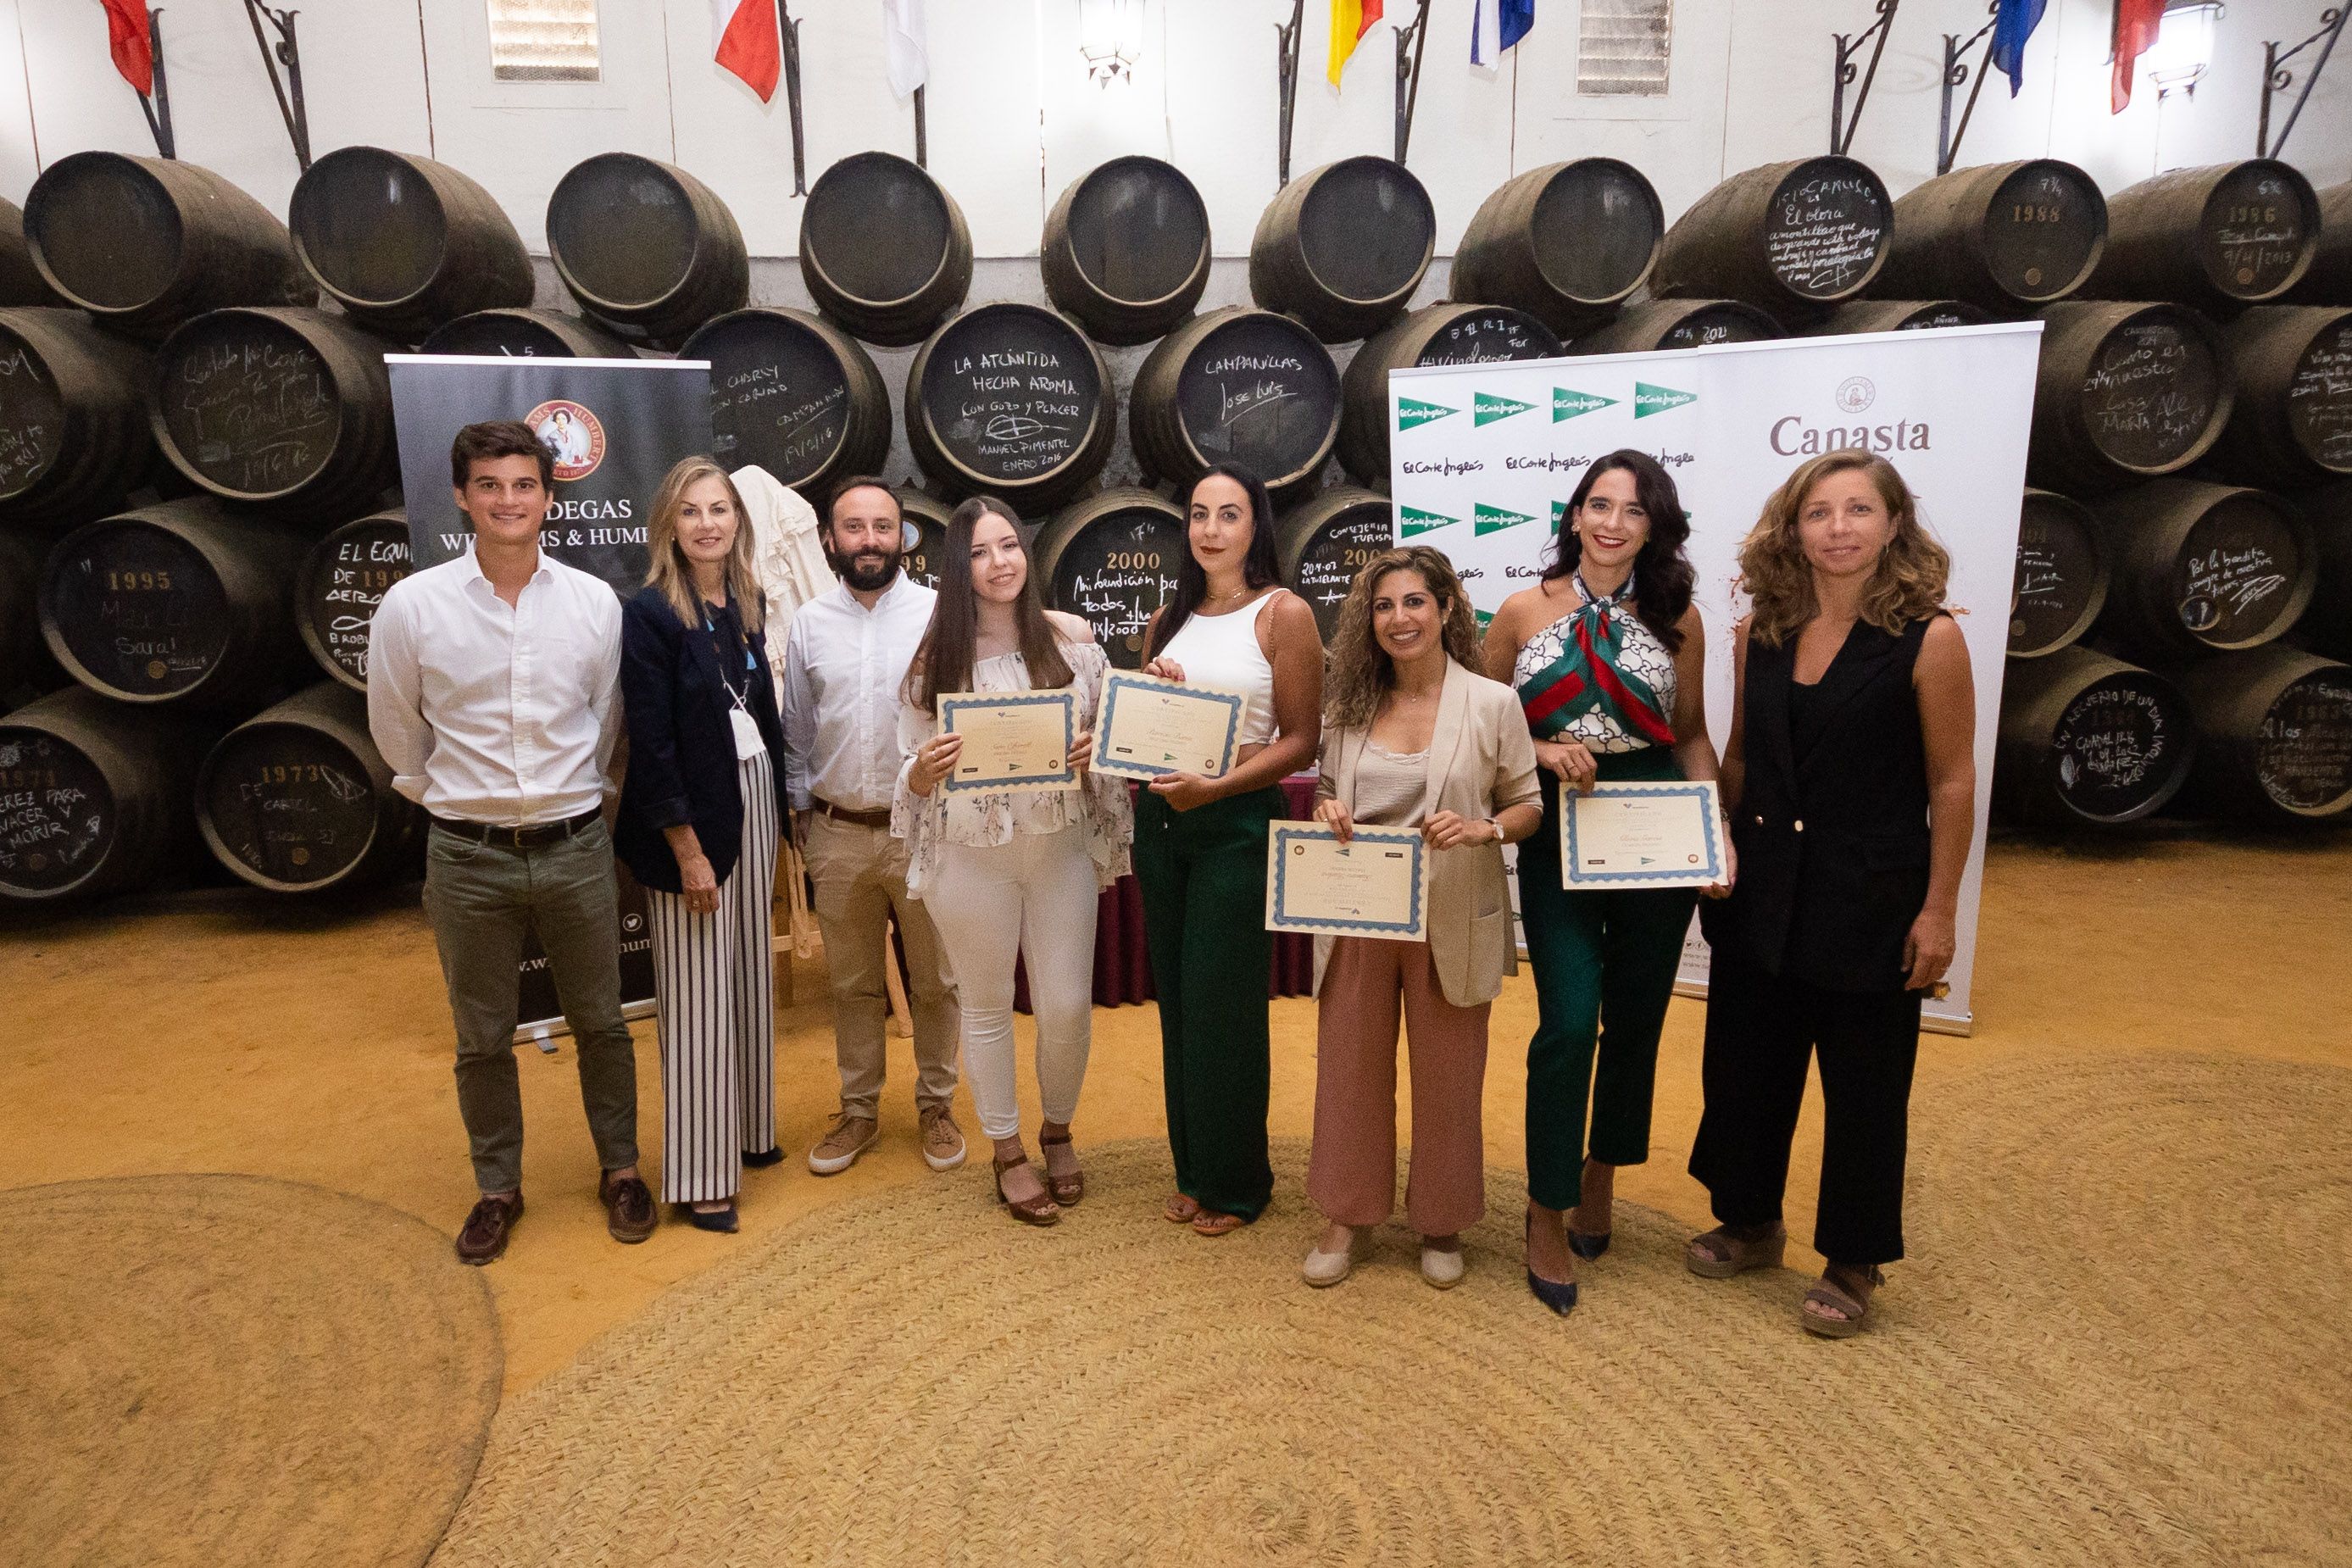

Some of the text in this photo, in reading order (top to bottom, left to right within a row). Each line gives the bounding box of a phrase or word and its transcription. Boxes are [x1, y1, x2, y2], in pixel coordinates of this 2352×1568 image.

[2012, 204, 2061, 223] 1988
[954, 356, 972, 375] LA
[972, 376, 1020, 392] HECHA
[1770, 415, 1932, 457] Canasta
[1403, 457, 1484, 476] El Corte Inglés
[1505, 452, 1591, 472] El Corte Inglés
[1660, 448, 1694, 469] Ingle
[544, 498, 633, 521] DEGAS
[566, 530, 585, 547] &
[1352, 534, 1392, 544] TURISM
[339, 542, 364, 563] EL
[1106, 552, 1160, 570] 2000
[108, 570, 172, 592] 1995
[333, 567, 357, 586] DE
[1456, 568, 1484, 582] glés
[1504, 565, 1517, 578] El
[260, 765, 320, 784] 1973
